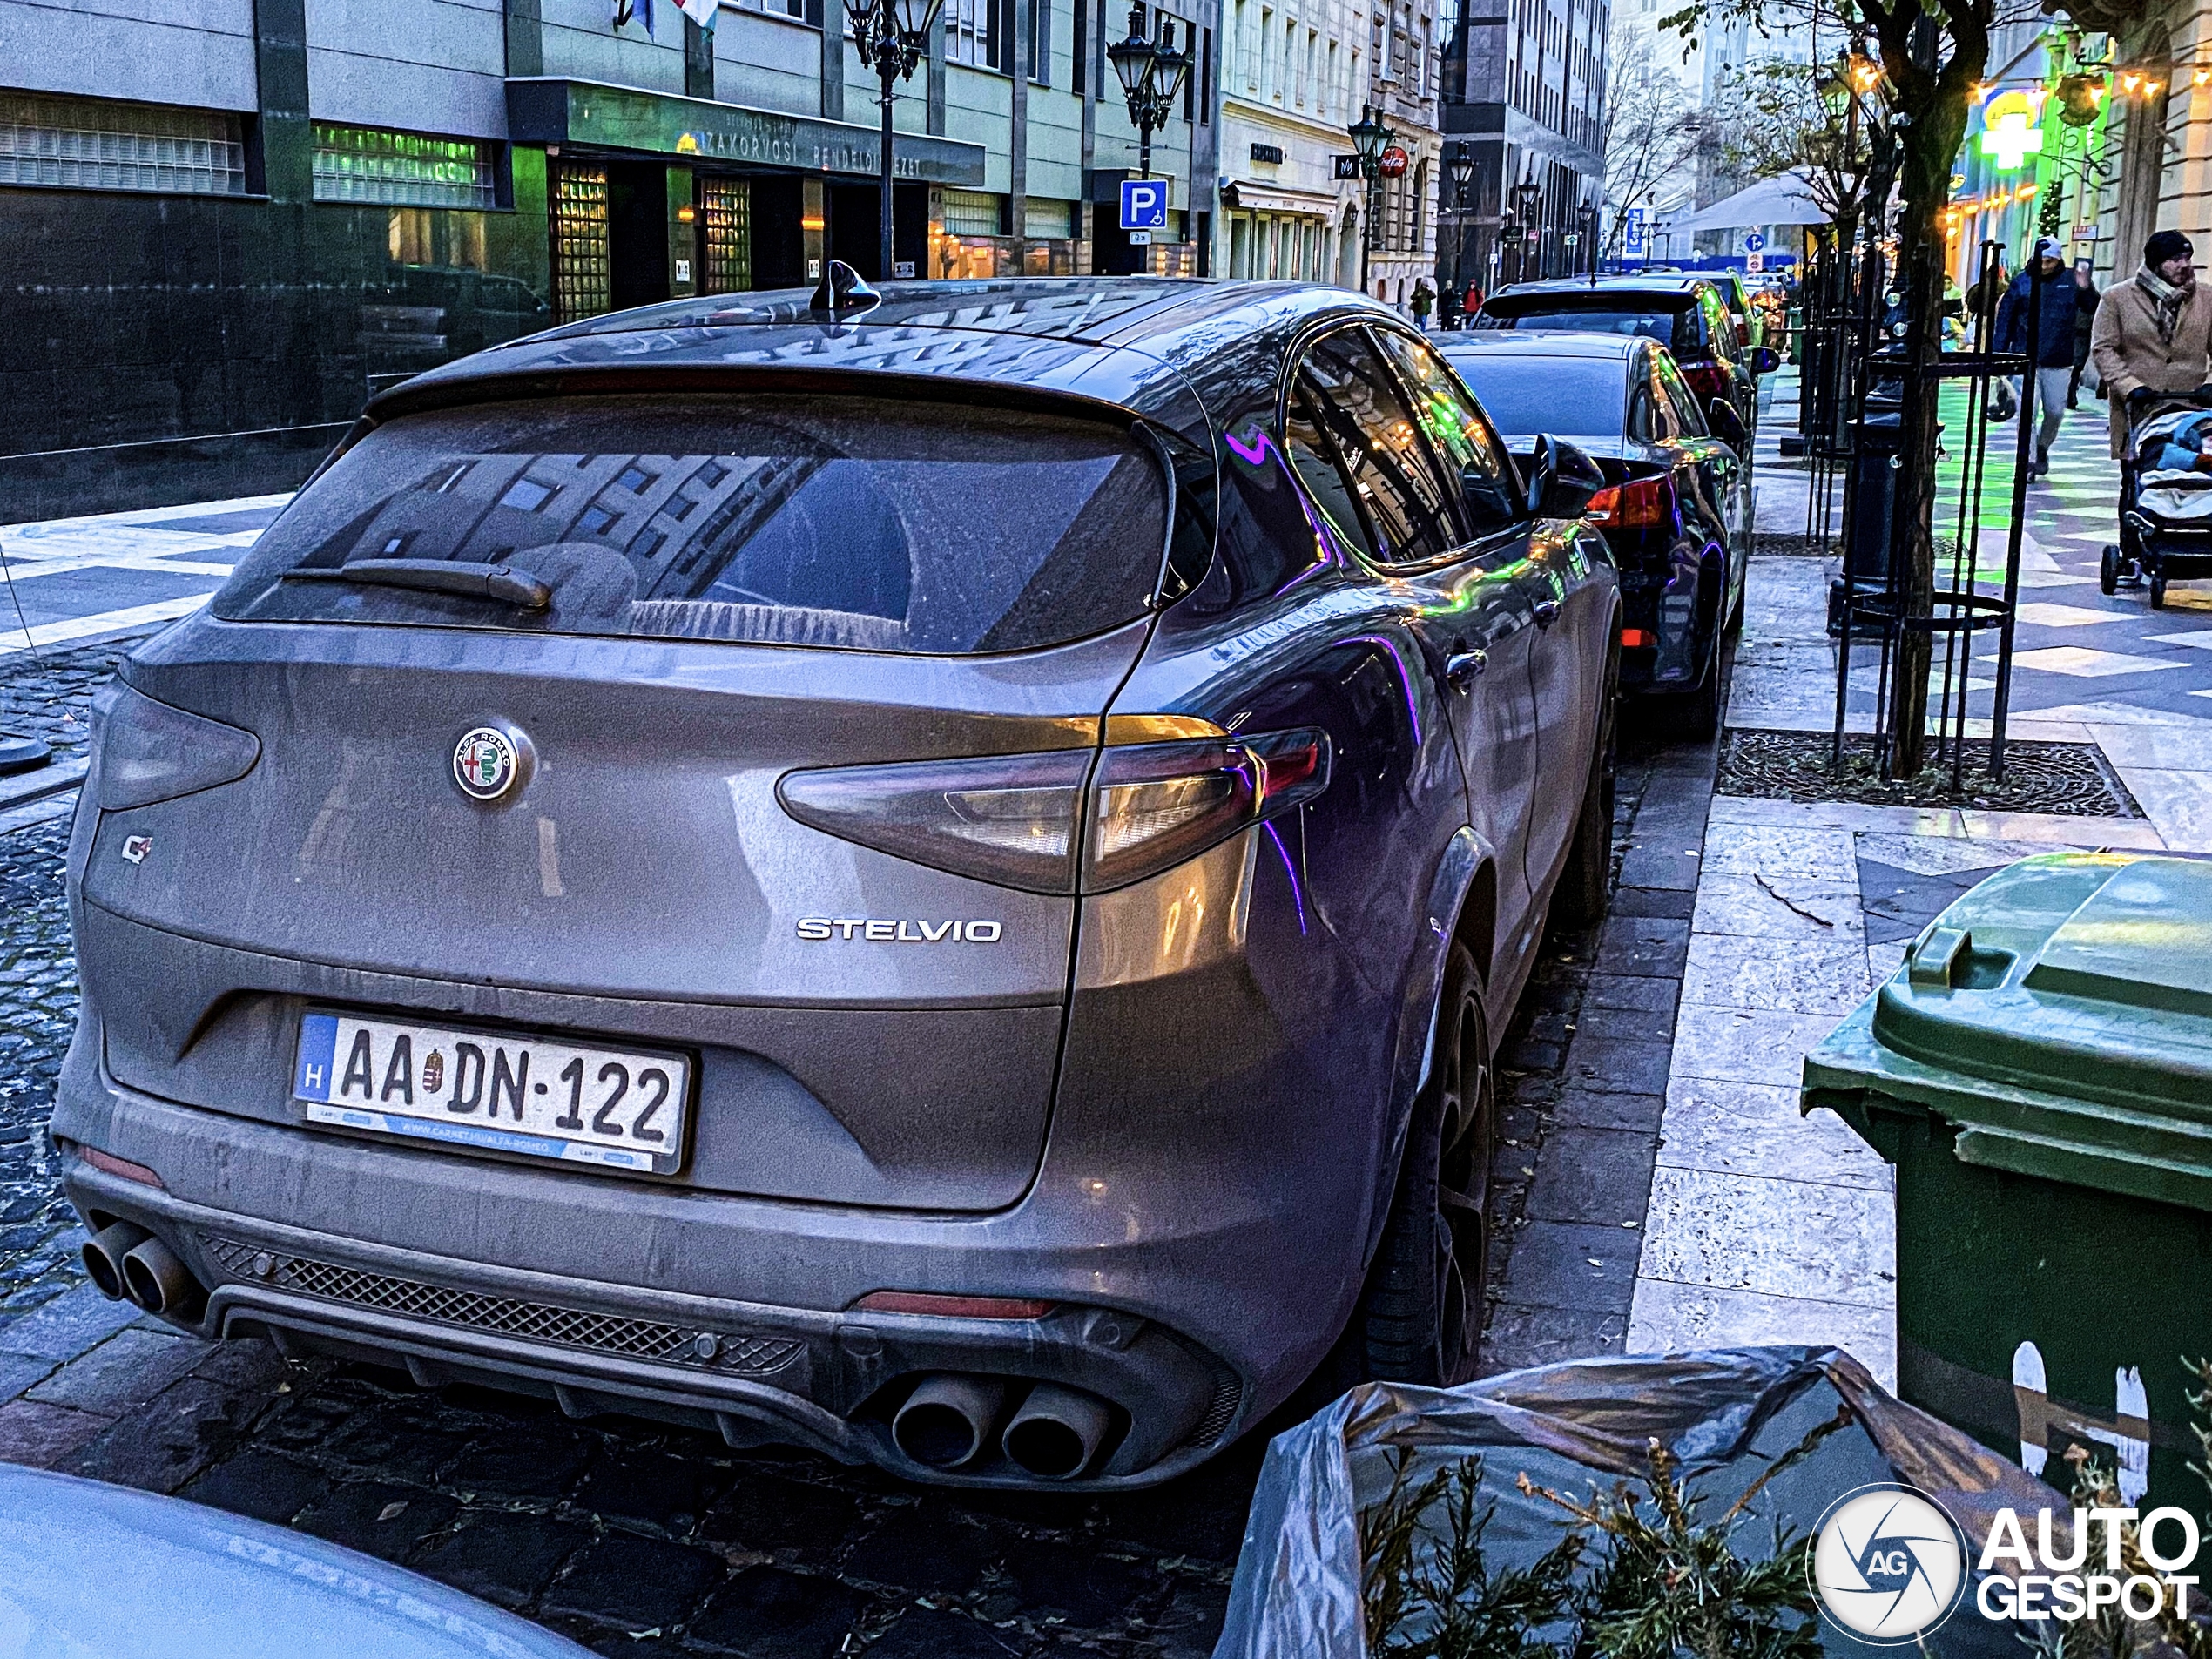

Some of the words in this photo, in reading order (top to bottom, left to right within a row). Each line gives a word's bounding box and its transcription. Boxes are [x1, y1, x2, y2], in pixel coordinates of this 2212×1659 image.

[1131, 187, 1156, 222] P
[457, 736, 476, 763] ALFA
[481, 733, 509, 767] ROMEO
[796, 917, 1002, 942] STELVIO
[305, 1063, 323, 1089] H
[341, 1028, 413, 1105] AA
